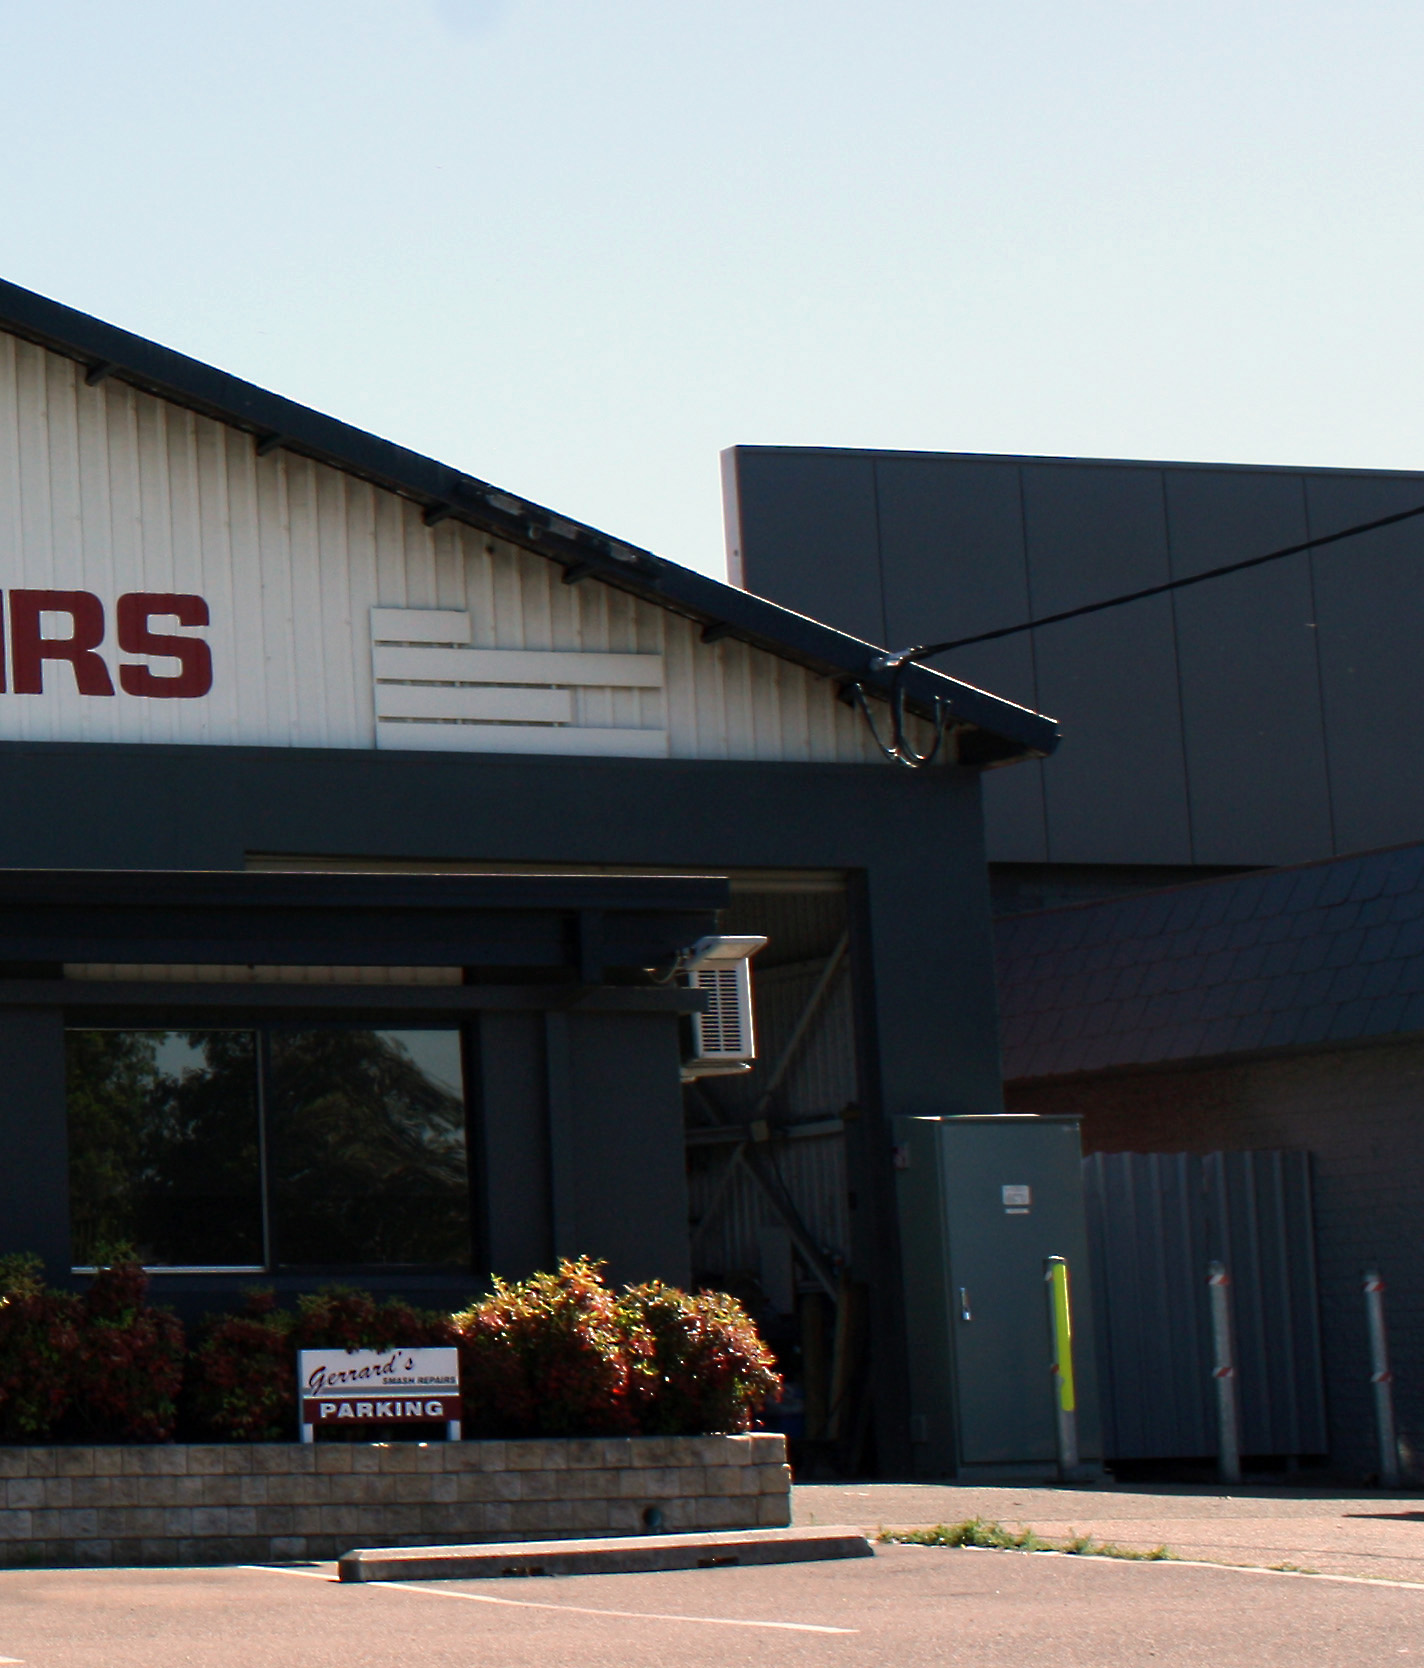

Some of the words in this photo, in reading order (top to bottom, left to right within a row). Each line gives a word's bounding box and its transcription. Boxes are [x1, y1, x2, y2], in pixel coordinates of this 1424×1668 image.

[308, 1351, 414, 1396] Gerrard's
[382, 1376, 415, 1385] SMASH
[417, 1376, 457, 1385] REPAIRS
[320, 1401, 444, 1418] PARKING
